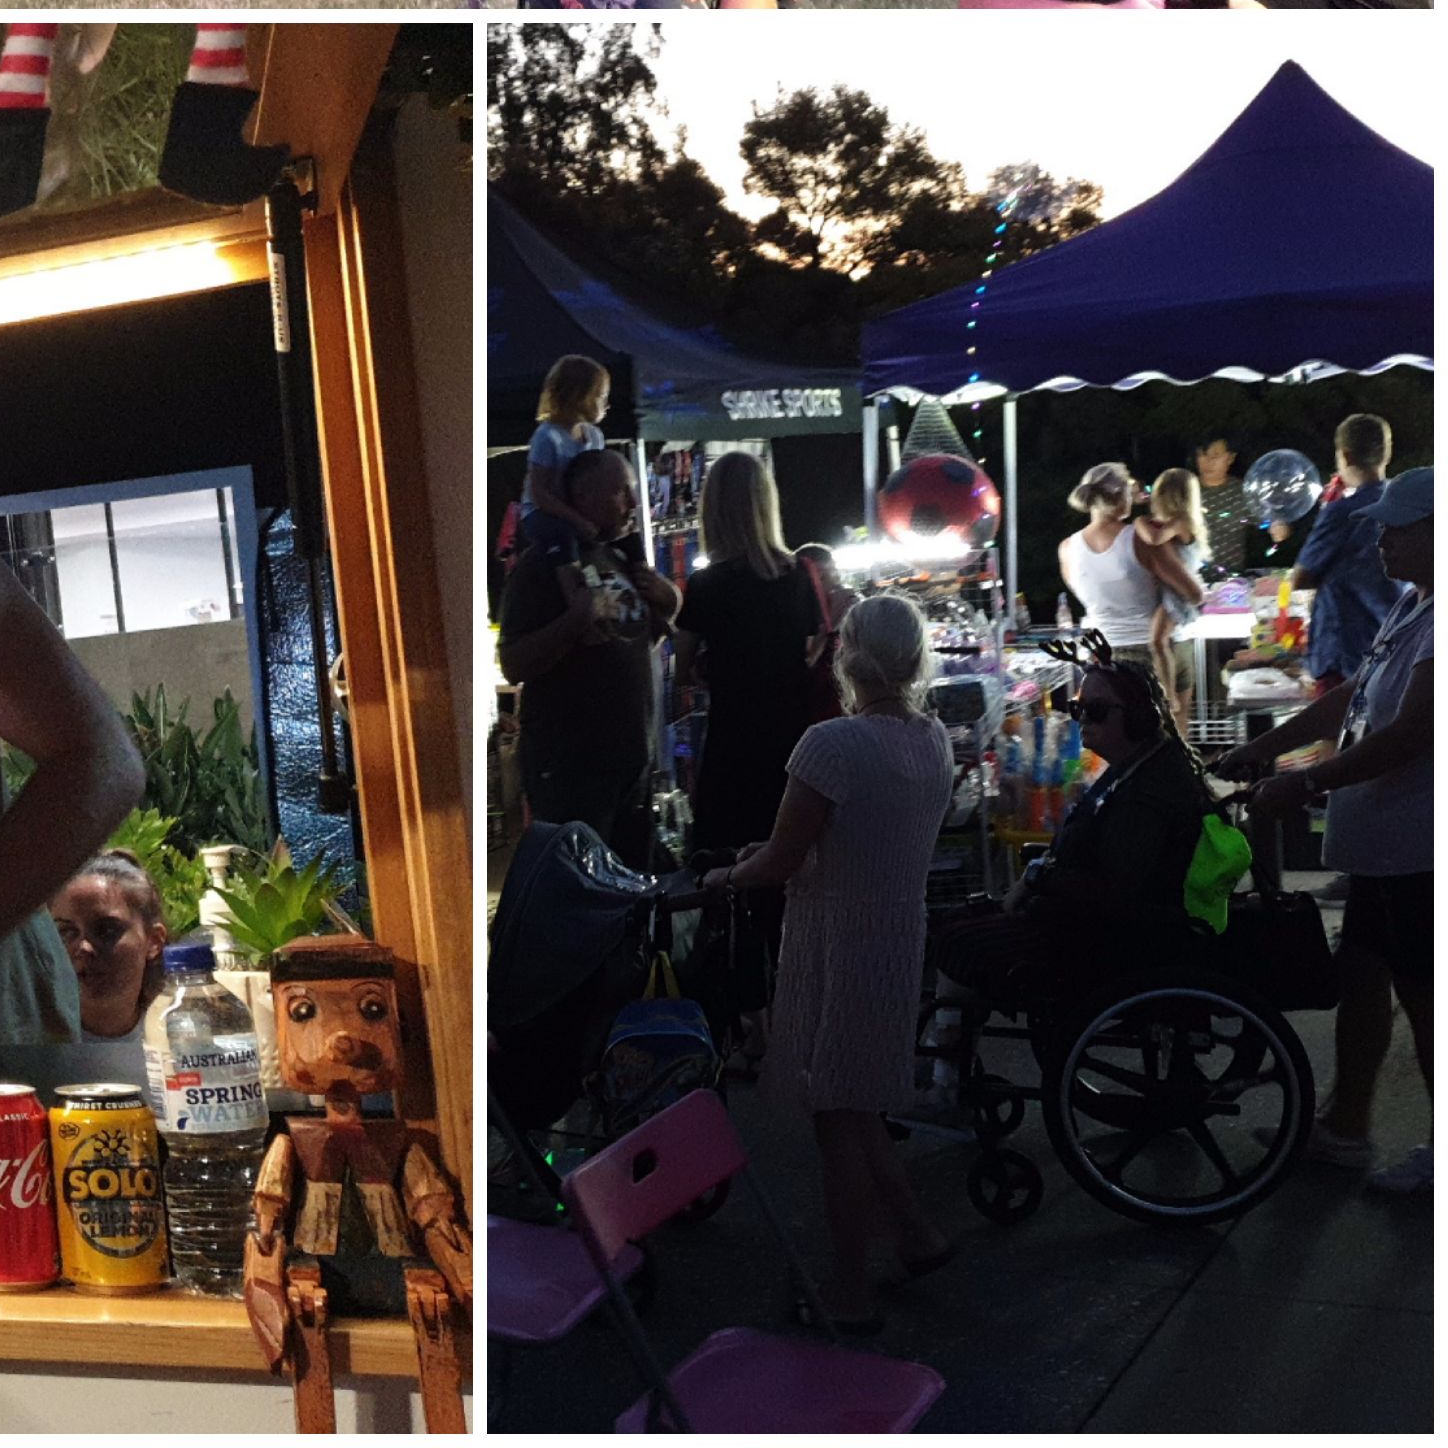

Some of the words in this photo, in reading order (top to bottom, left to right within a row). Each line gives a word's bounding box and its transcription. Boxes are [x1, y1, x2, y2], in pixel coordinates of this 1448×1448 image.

[781, 388, 842, 418] SPORTS
[185, 1081, 262, 1105] SPRING
[68, 1168, 157, 1200] SOLO
